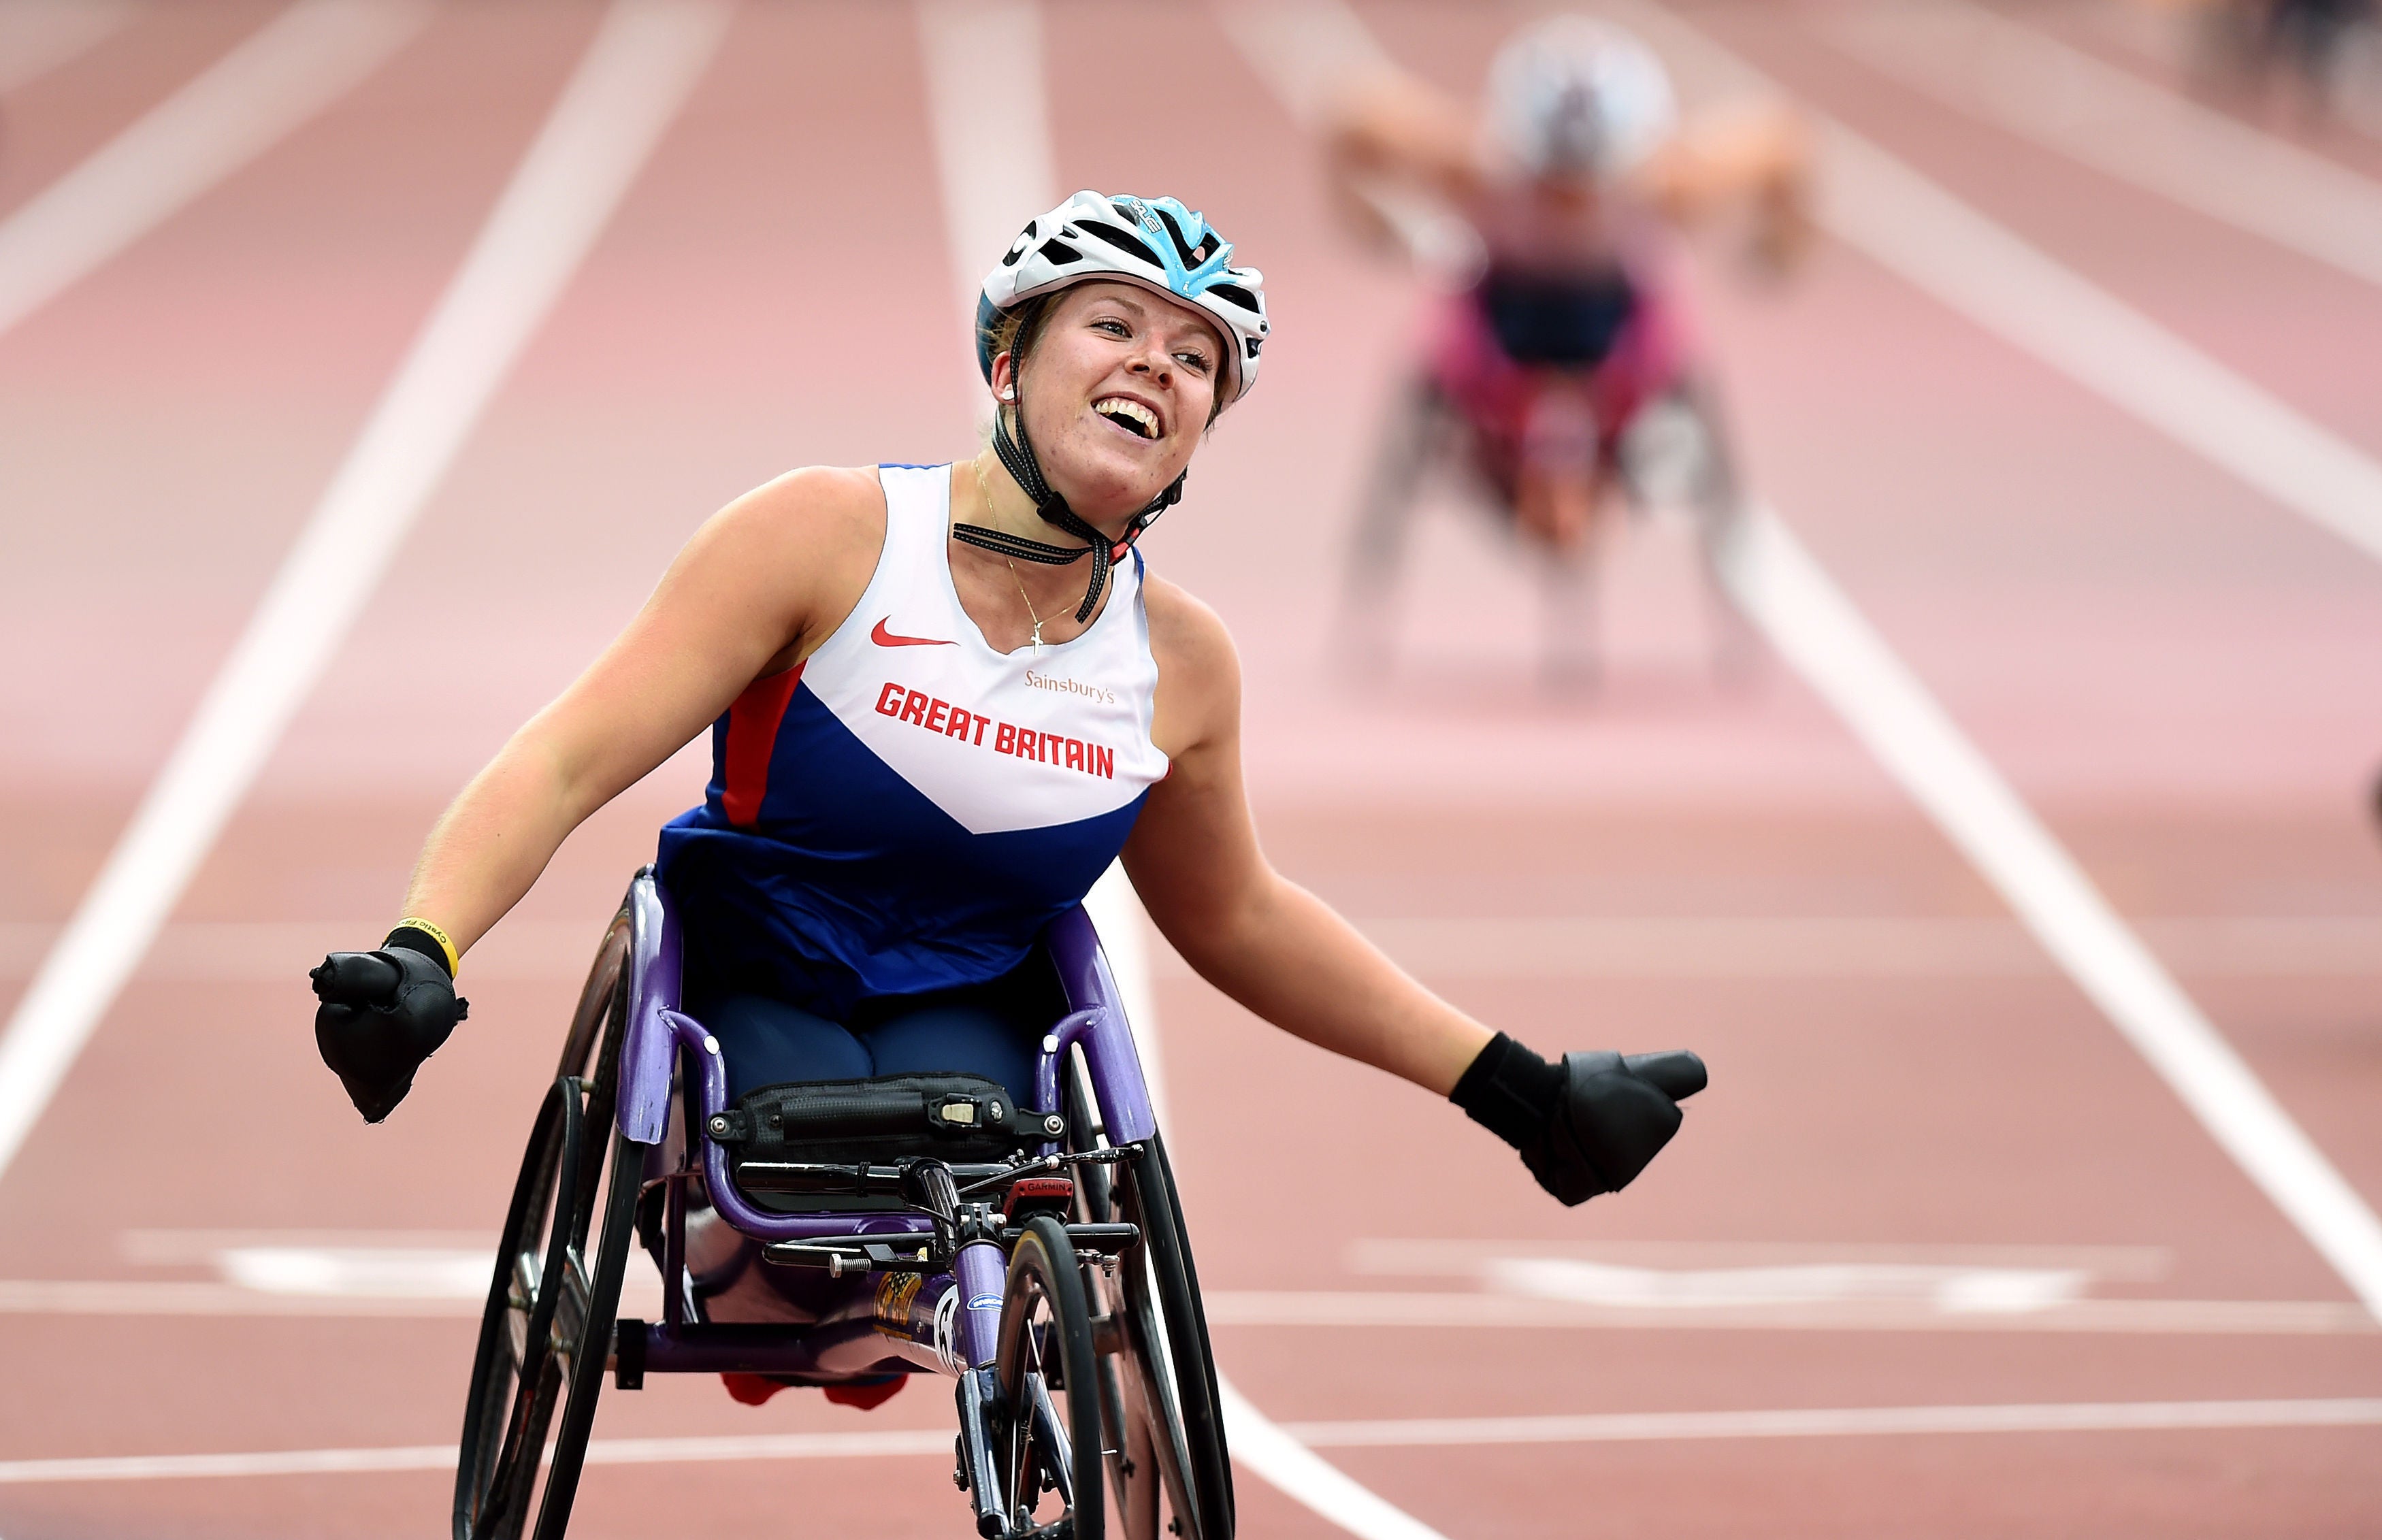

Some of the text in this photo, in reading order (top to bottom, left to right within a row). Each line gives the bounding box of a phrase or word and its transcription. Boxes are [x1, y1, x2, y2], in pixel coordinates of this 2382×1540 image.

[1025, 670, 1114, 704] Sainsbury's
[875, 682, 1113, 780] GREAT BRITAIN
[1028, 1183, 1066, 1191] GARMIN
